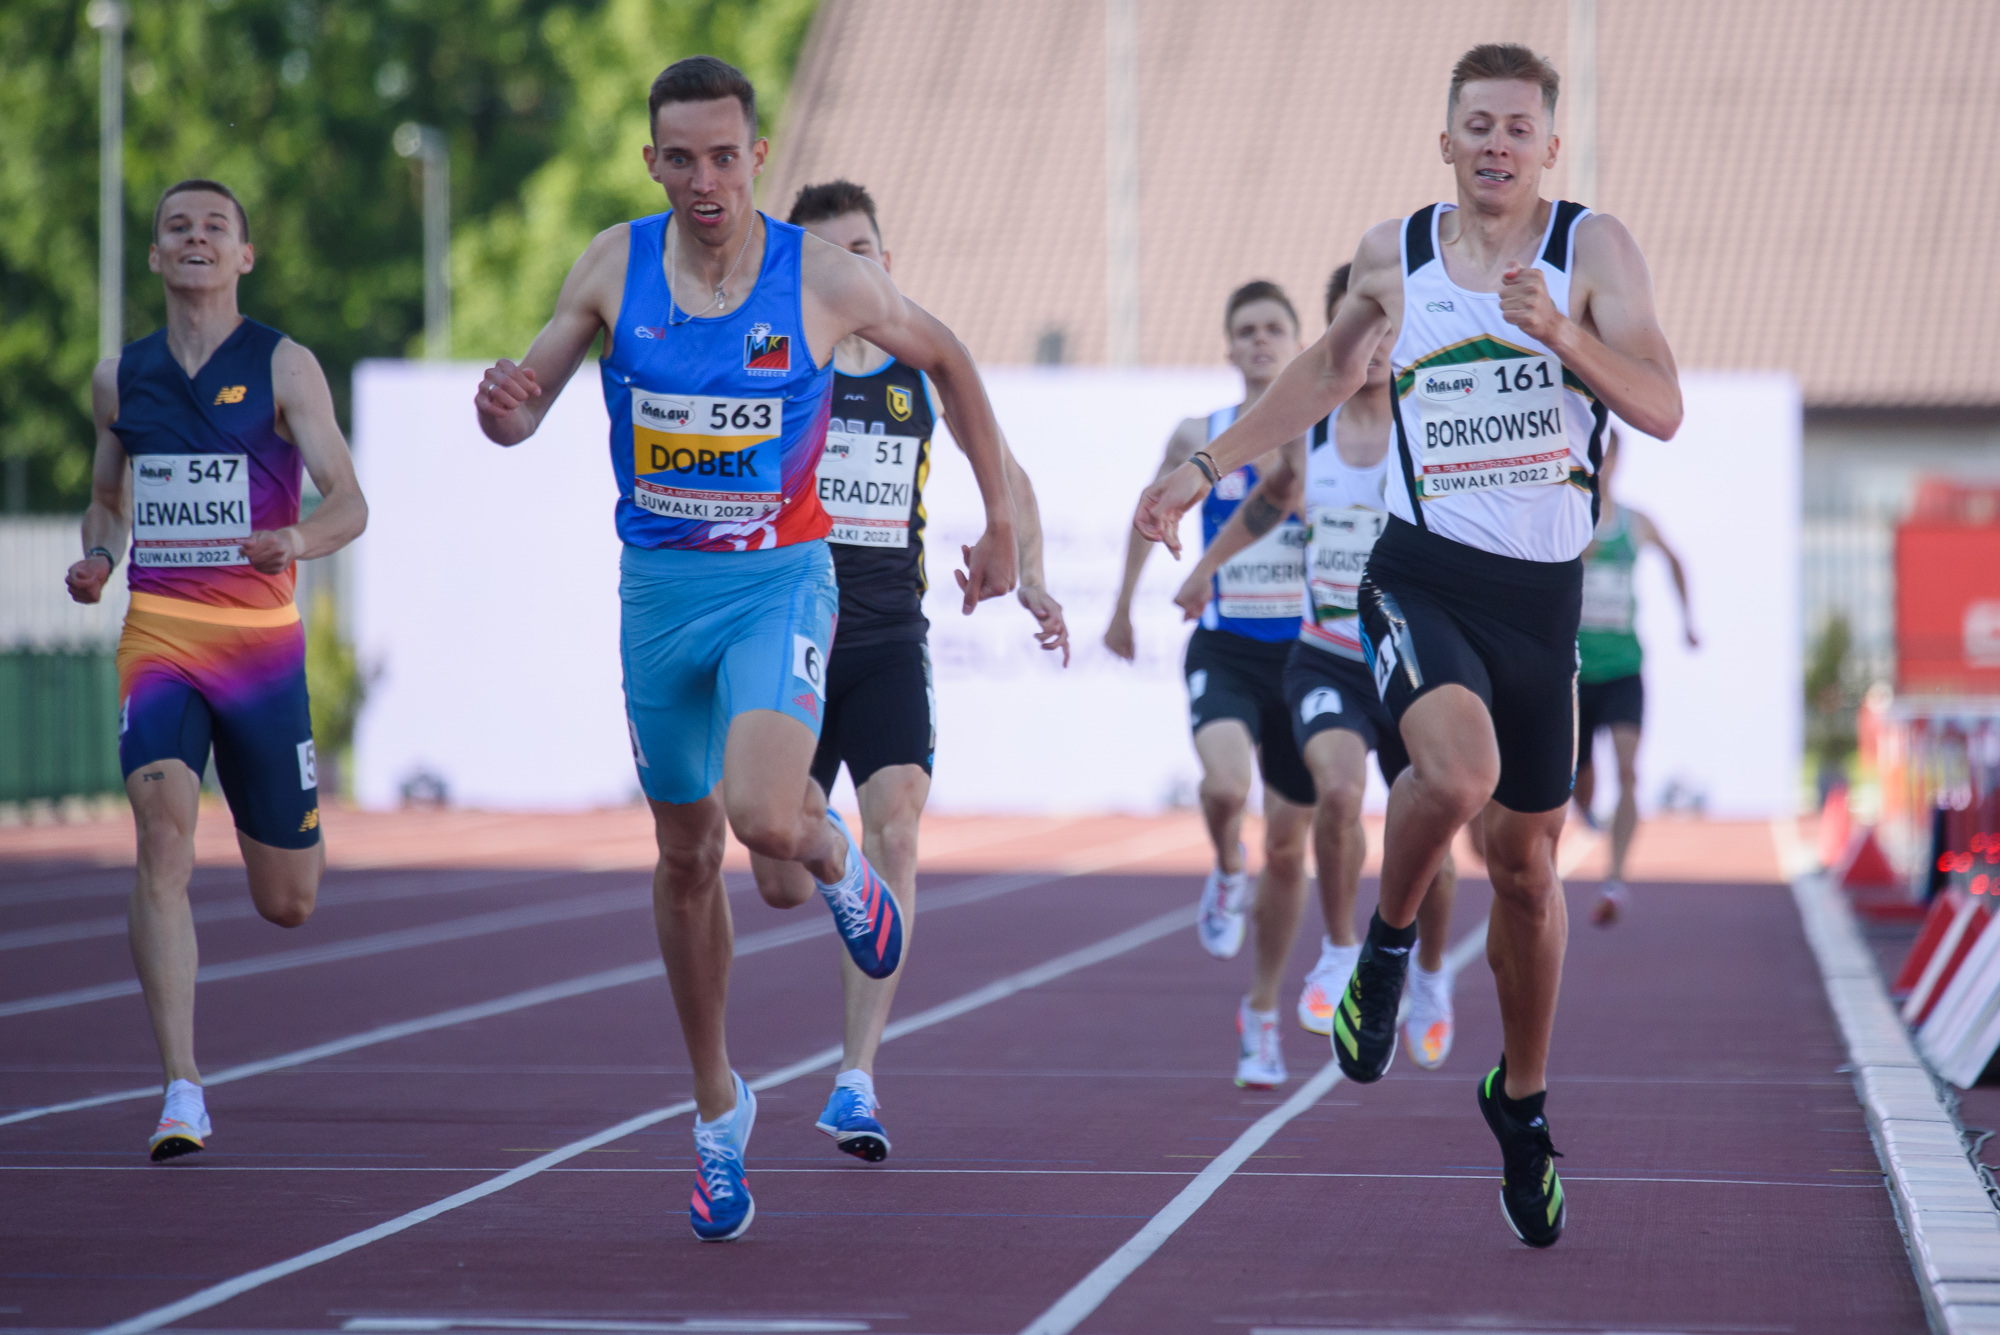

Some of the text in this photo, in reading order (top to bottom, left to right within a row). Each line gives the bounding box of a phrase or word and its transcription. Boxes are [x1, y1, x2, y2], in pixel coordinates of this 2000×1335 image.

[1494, 361, 1554, 394] 161
[709, 403, 771, 430] 563
[1426, 407, 1562, 449] BORKOWSKI
[651, 444, 758, 478] DOBEK
[875, 441, 904, 465] 51
[188, 459, 239, 485] 547
[1432, 467, 1549, 491] SUWAŁKI 2022
[138, 500, 245, 526] LEWALSKI
[640, 494, 754, 518] SUWAŁKI 2022
[863, 530, 890, 543] 2022
[197, 550, 230, 563] 2022
[805, 646, 820, 687] 6
